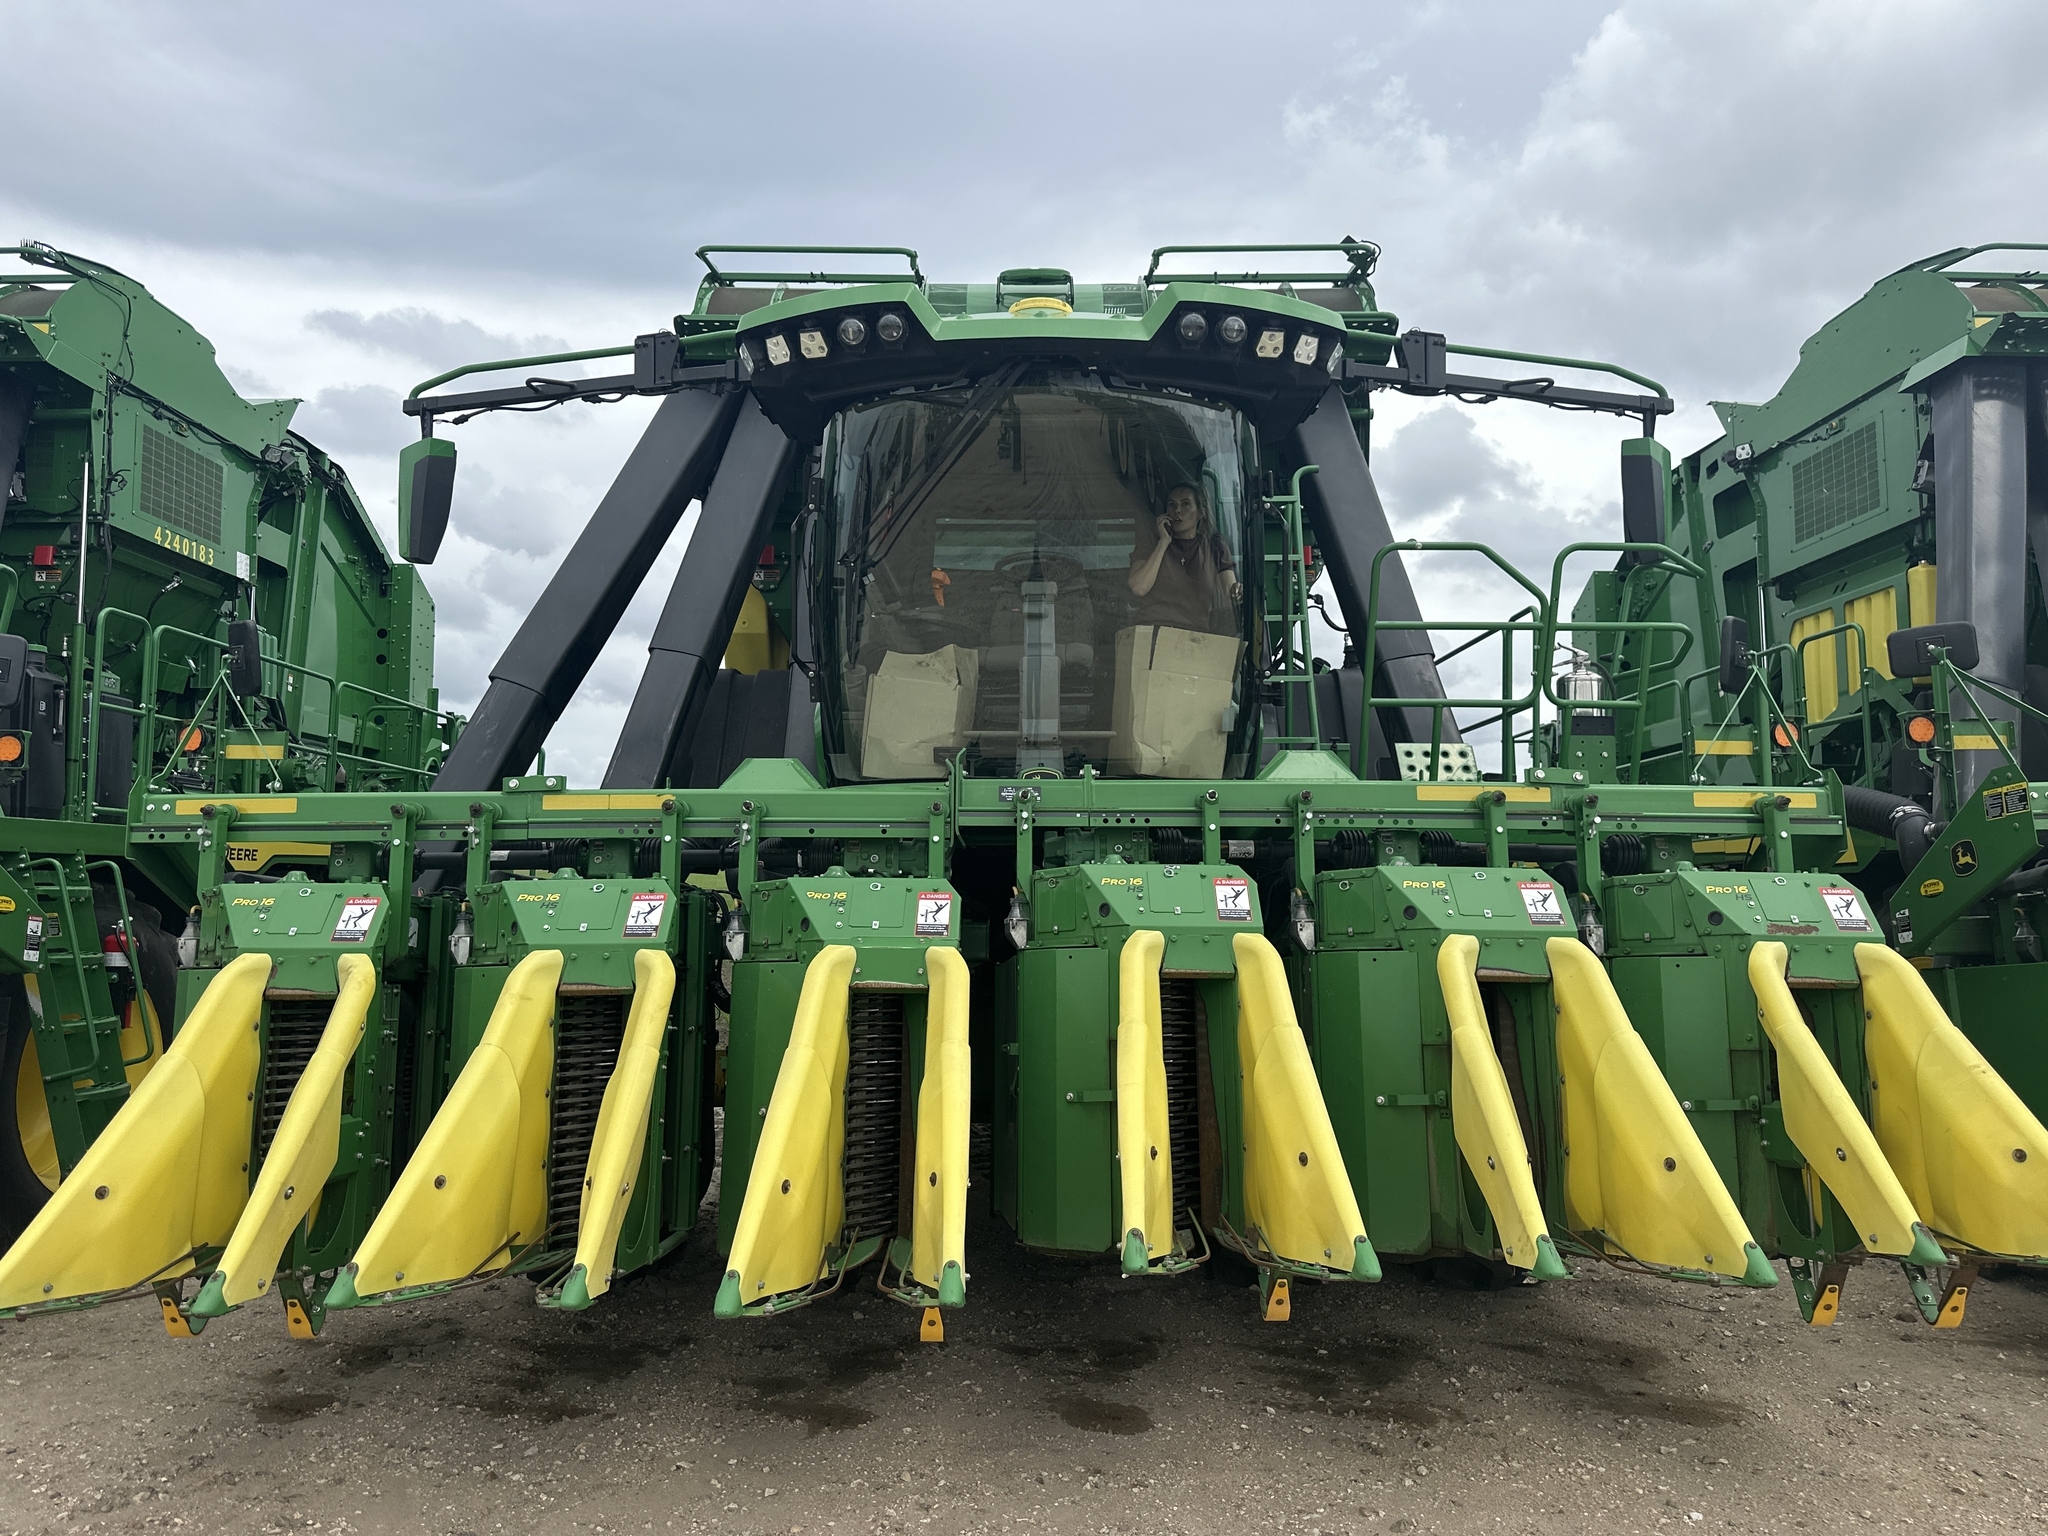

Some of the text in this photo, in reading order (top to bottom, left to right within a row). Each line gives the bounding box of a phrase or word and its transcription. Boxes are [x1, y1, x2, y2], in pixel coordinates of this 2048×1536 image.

[154, 526, 214, 566] 4240183
[1129, 878, 1143, 886] 16
[1431, 881, 1446, 889] 16
[259, 898, 276, 906] 16
